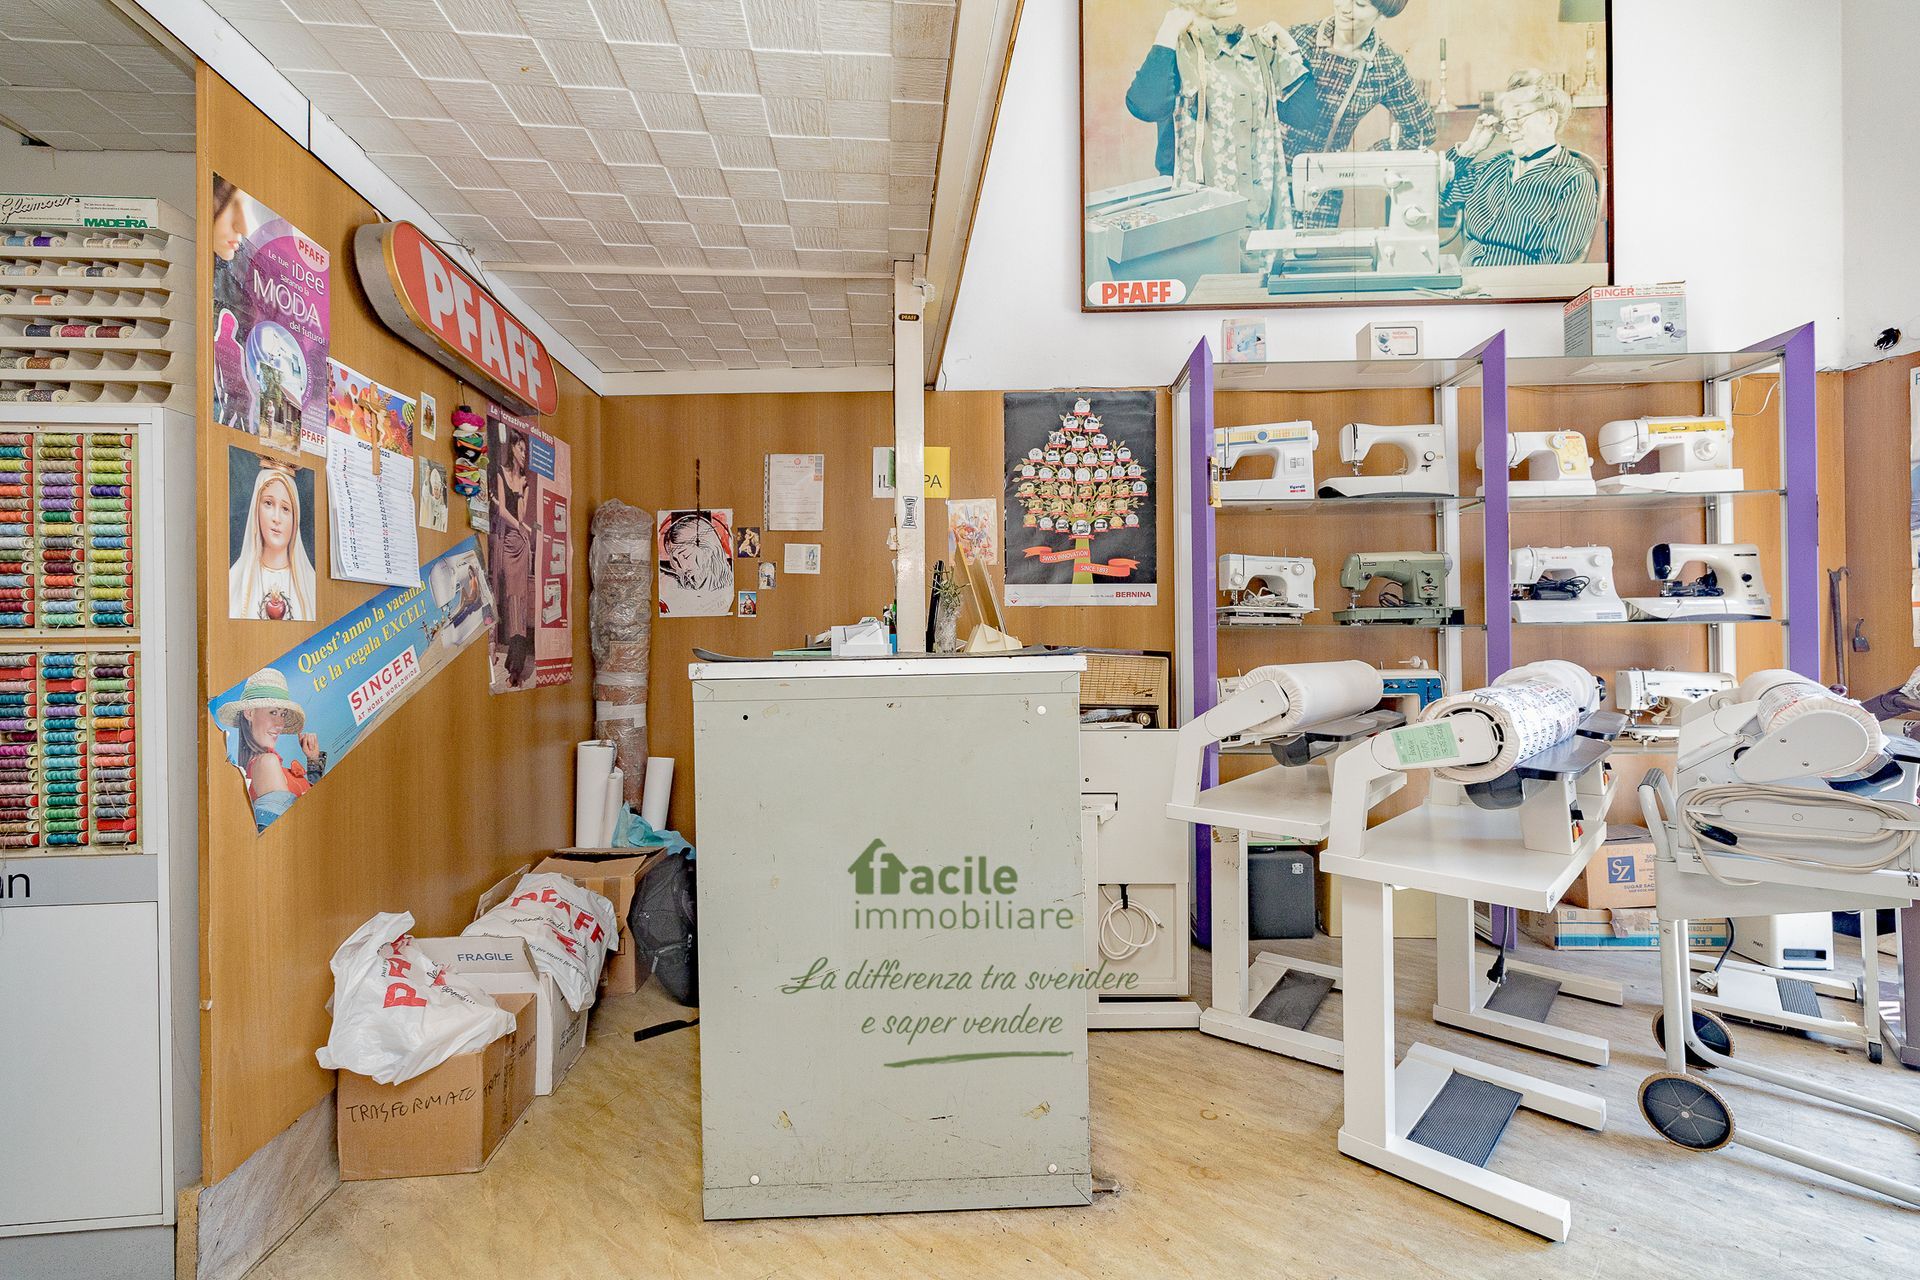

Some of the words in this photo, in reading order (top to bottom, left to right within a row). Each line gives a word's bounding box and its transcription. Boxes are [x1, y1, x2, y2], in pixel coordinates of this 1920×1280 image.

[83, 218, 148, 228] MADEIRA
[268, 249, 276, 260] Le
[278, 255, 289, 268] tue
[298, 238, 325, 265] PFAFF
[254, 268, 323, 331] MODA
[1102, 281, 1171, 304] PFAFF
[1564, 292, 1589, 314] SINGER
[1593, 287, 1635, 298] SINGER
[290, 321, 300, 332] del
[419, 241, 543, 401] PFAFF
[301, 428, 325, 445] PFAFF
[1058, 550, 1089, 560] INNOVATION
[298, 616, 372, 673] Quest'anno
[372, 607, 385, 622] la
[313, 673, 329, 692] te
[328, 664, 344, 681] la
[344, 636, 382, 670] regala
[381, 600, 427, 641] EXCEL!
[351, 650, 414, 710] SINGER
[367, 696, 384, 712] HOME
[385, 667, 418, 697] WORLDWIDE
[457, 953, 514, 962] FRAGILE
